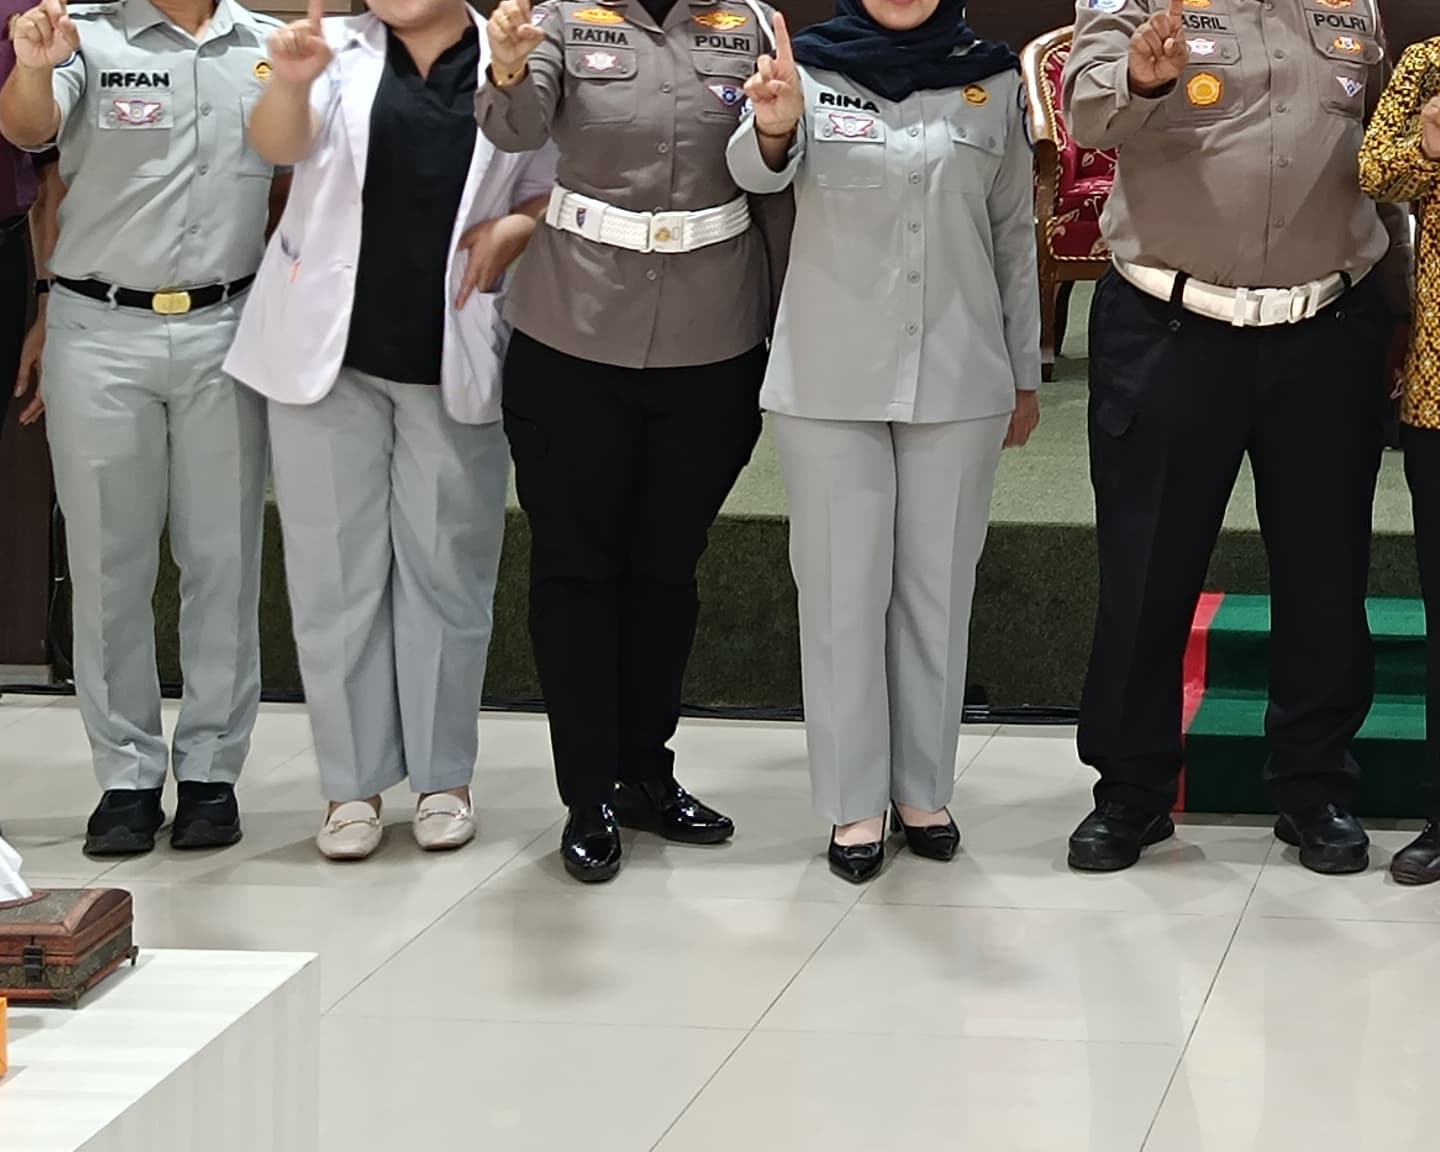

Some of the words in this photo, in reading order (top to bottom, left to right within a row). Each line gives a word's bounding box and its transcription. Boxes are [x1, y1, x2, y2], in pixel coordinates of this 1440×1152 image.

[1313, 13, 1366, 33] POLRI
[572, 28, 628, 46] RATNA
[695, 35, 751, 52] POLRI
[100, 71, 170, 89] IRFAN
[819, 92, 880, 113] RINA
